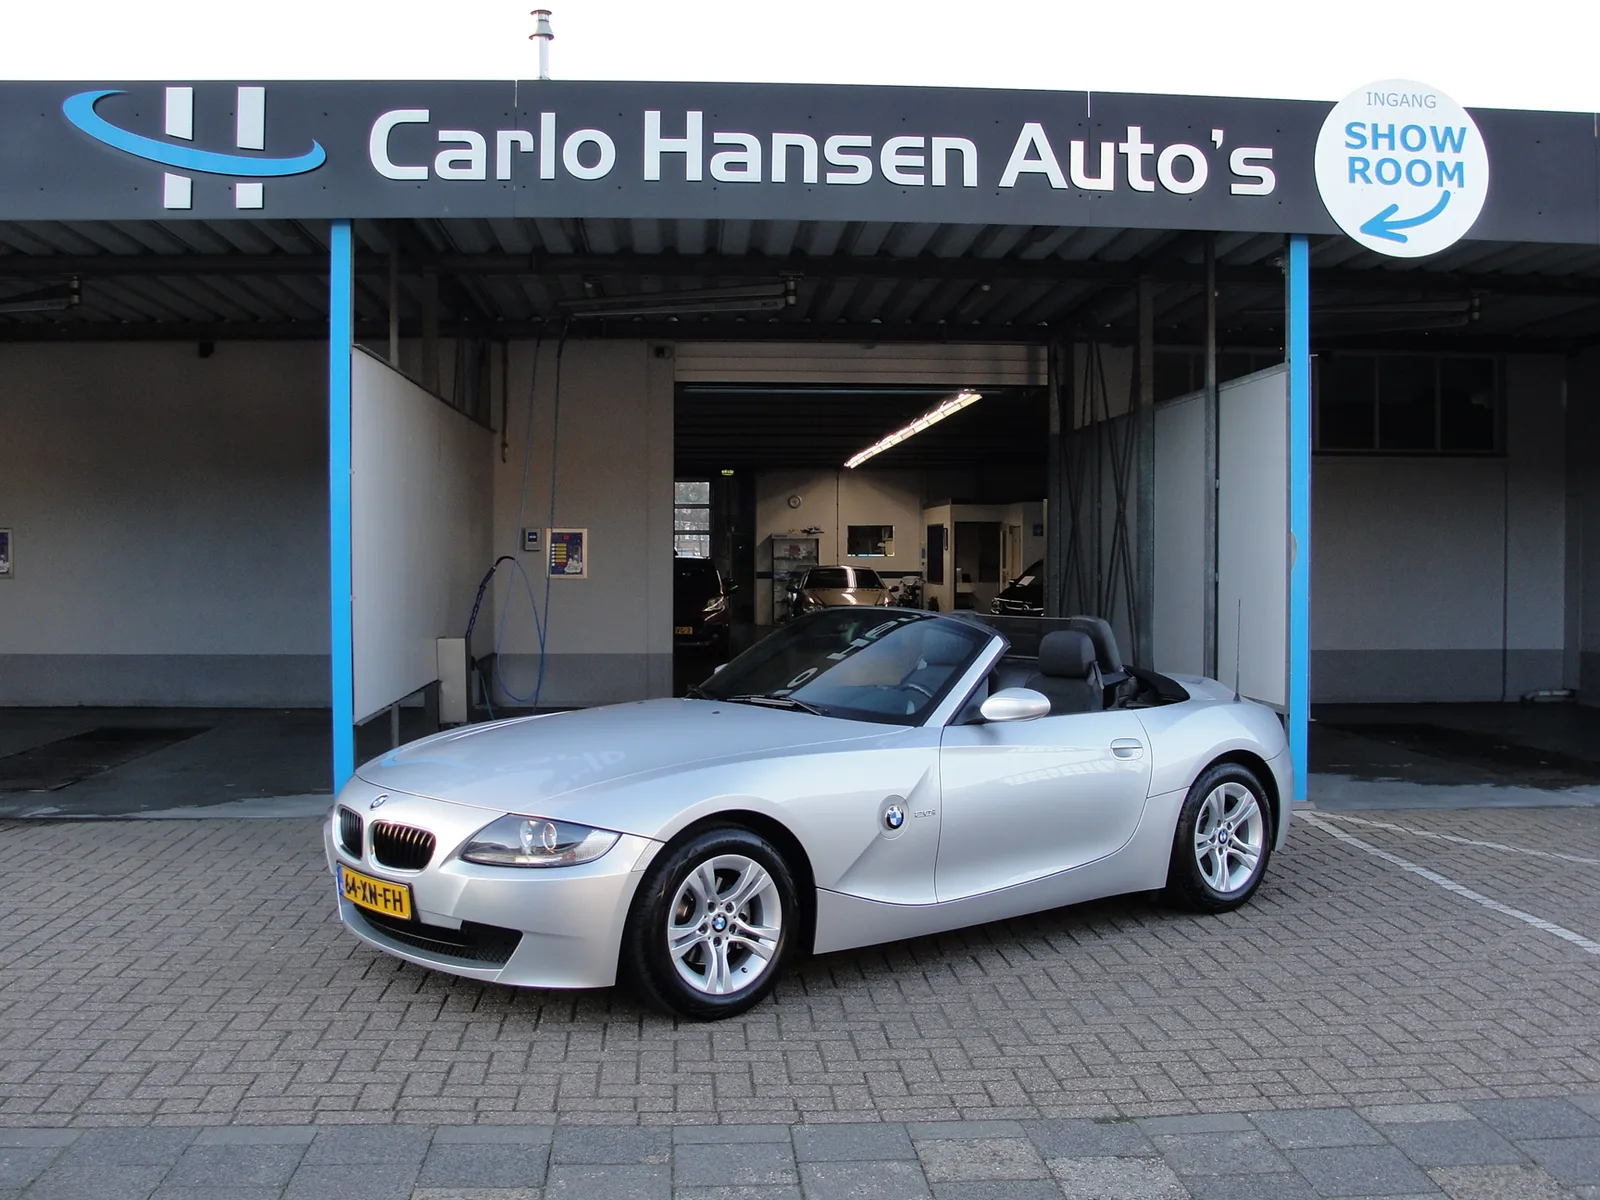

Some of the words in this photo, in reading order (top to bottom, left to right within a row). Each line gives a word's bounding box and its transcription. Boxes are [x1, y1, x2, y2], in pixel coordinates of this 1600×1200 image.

[1366, 91, 1436, 109] INGANG
[369, 109, 616, 181] Carlo
[643, 110, 978, 188] Hansen
[998, 122, 1277, 196] Auto's
[1344, 121, 1467, 154] SHOW
[1348, 156, 1465, 189] ROOM
[344, 873, 404, 913] 64-XN-FH
